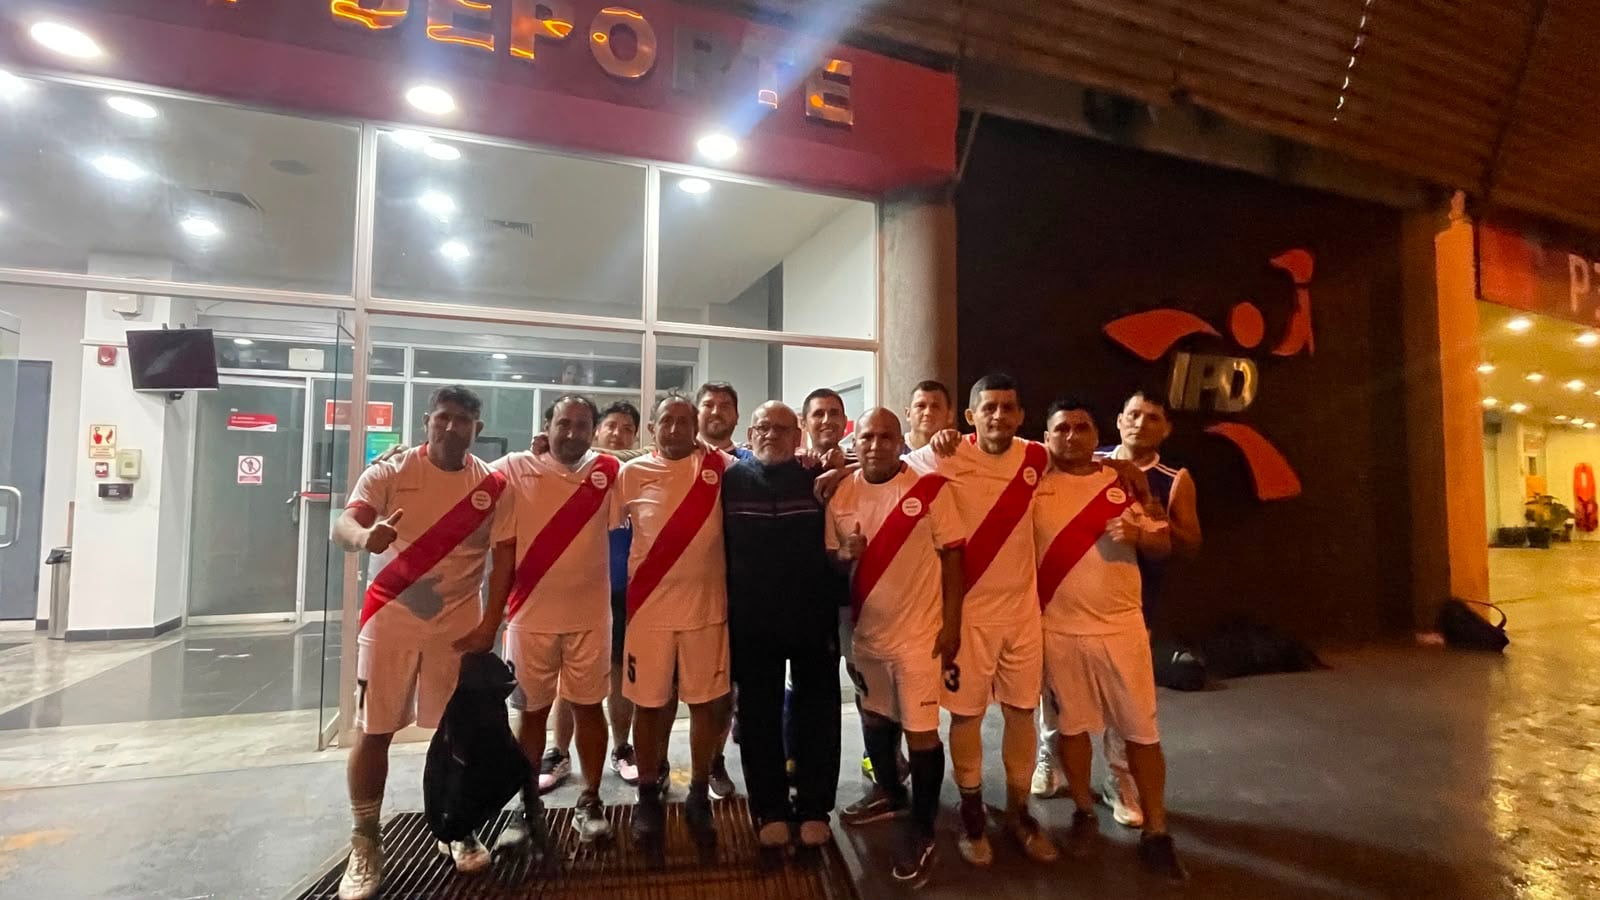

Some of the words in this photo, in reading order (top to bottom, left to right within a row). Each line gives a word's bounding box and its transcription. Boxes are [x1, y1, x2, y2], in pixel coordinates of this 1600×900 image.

[1568, 254, 1600, 322] P
[1168, 351, 1259, 413] IPD
[627, 652, 637, 684] 5
[944, 663, 961, 693] 3
[357, 679, 369, 710] 7
